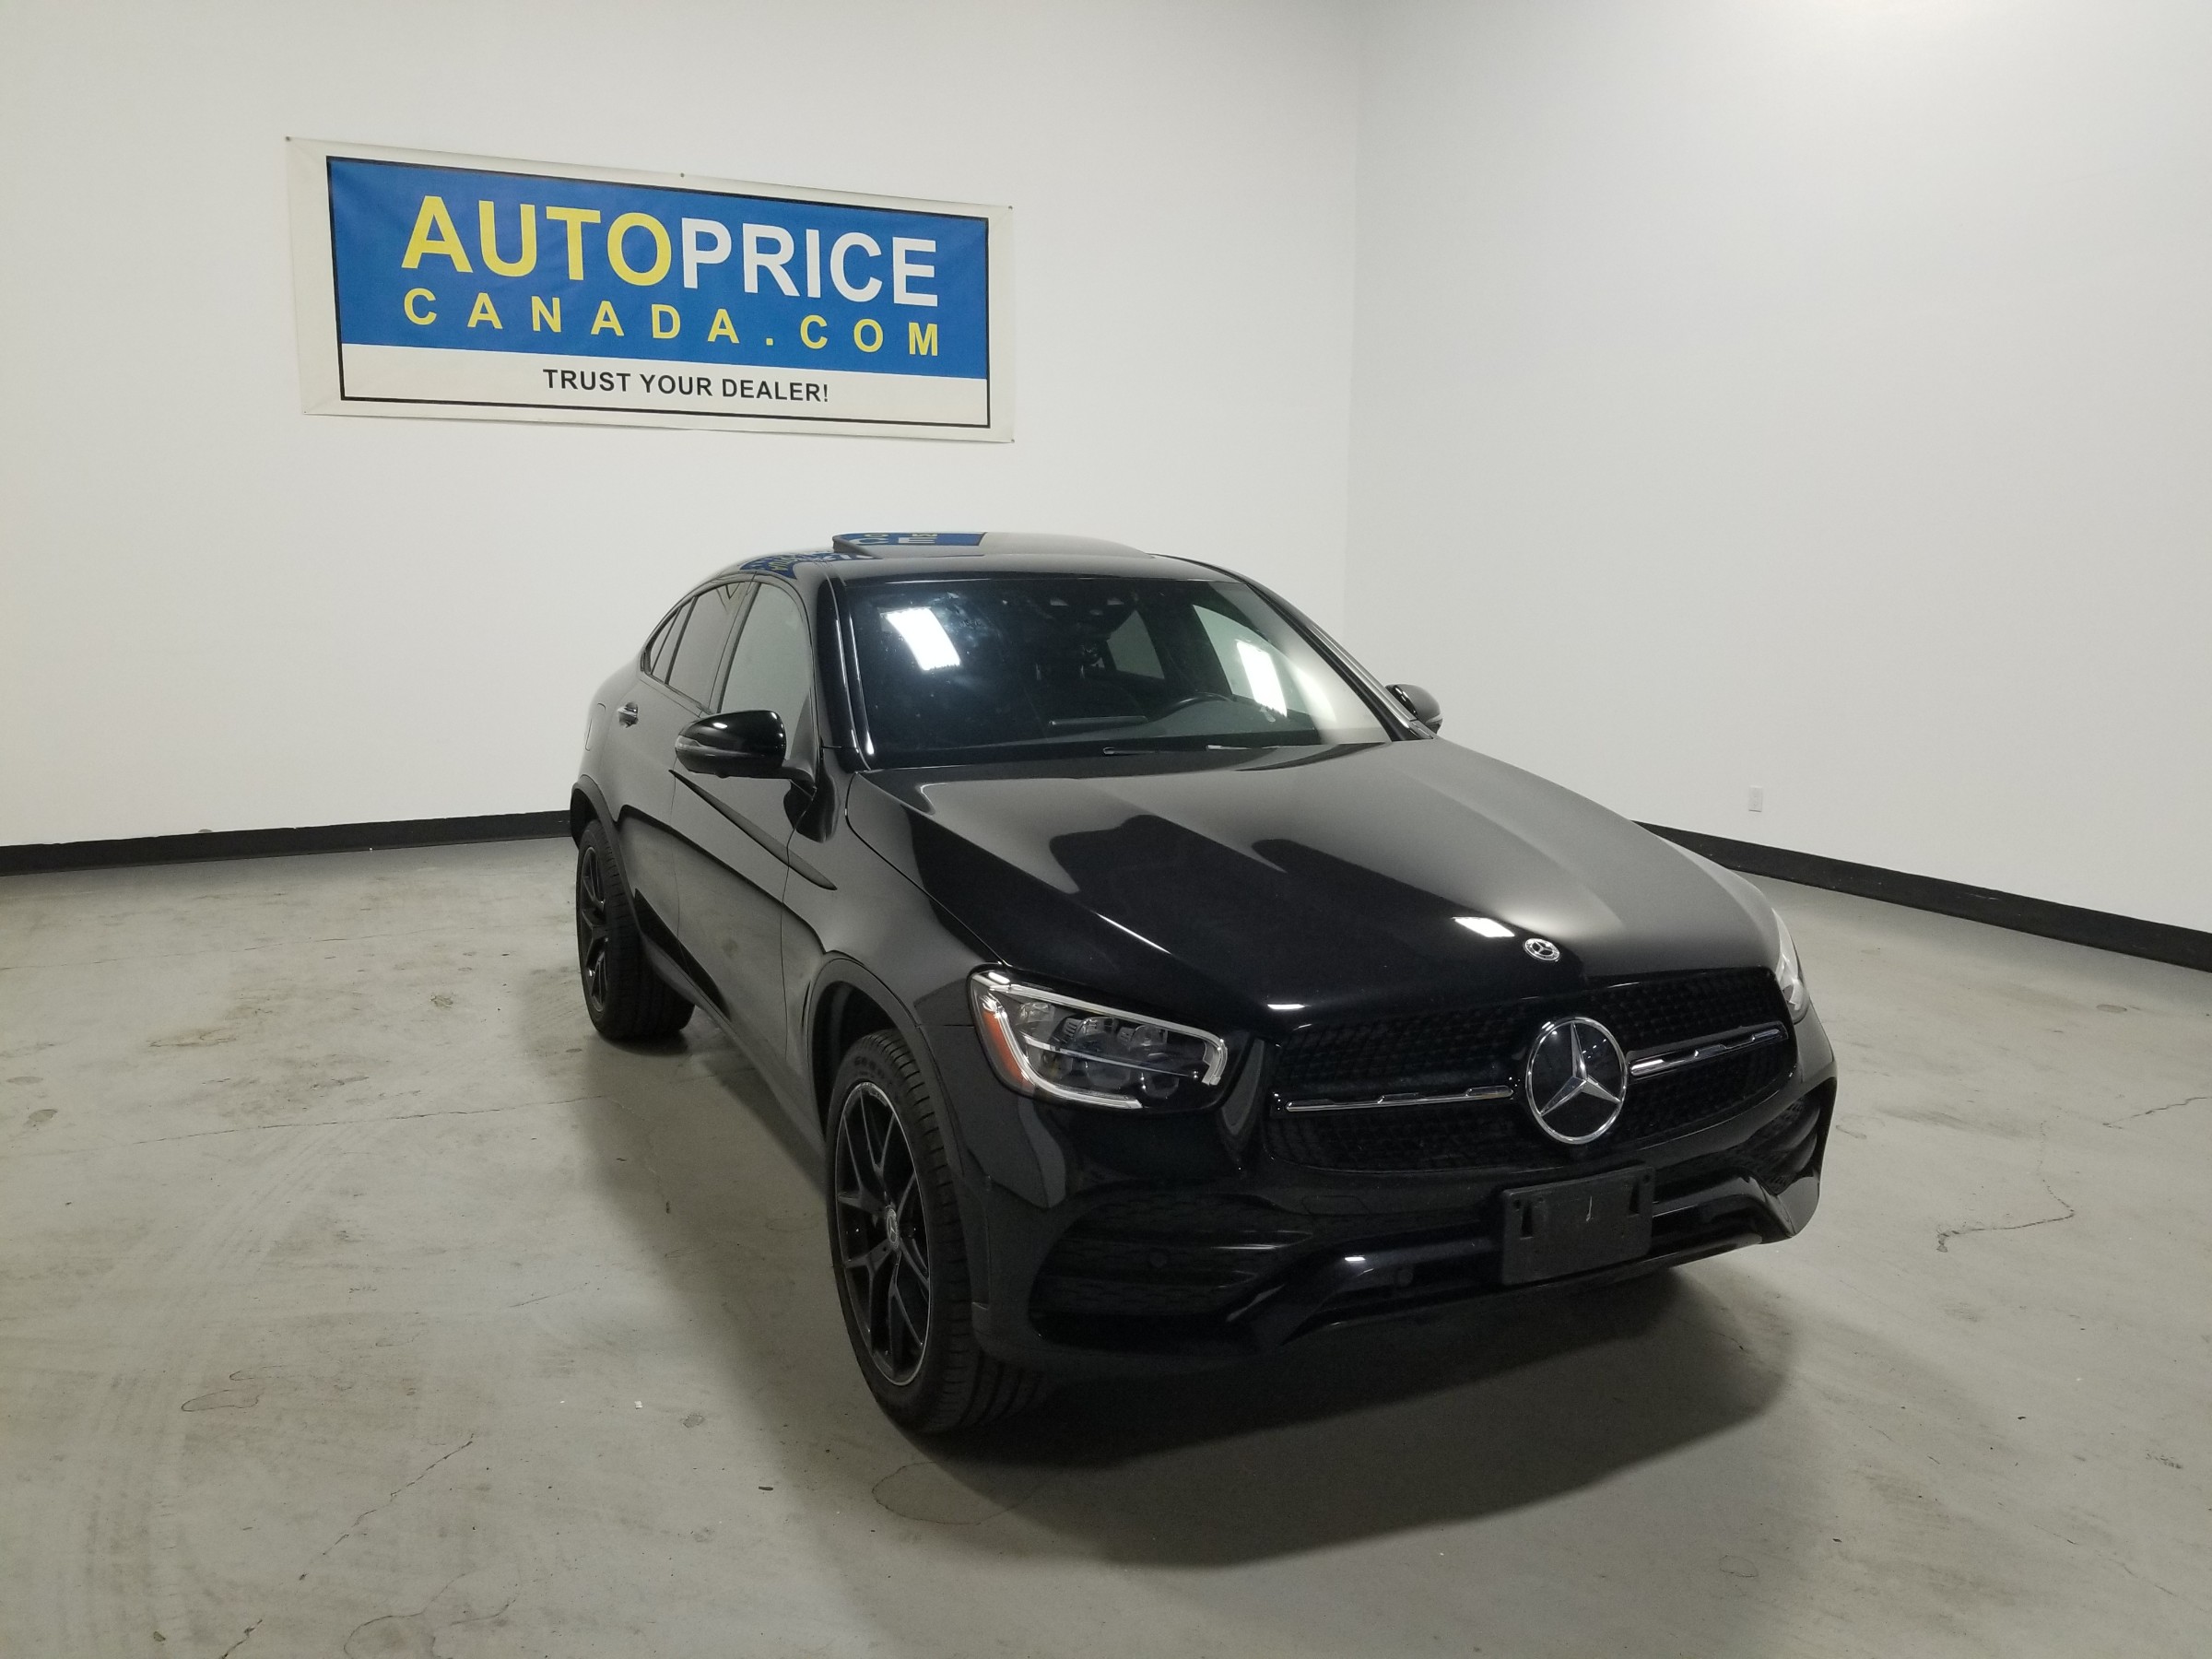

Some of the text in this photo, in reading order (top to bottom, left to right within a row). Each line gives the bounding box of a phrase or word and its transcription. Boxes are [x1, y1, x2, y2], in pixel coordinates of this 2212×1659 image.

[401, 194, 938, 307] AUTOPRICE
[404, 288, 938, 357] CANADA.COM
[542, 369, 829, 403] TRUST YOUR DEALER!
